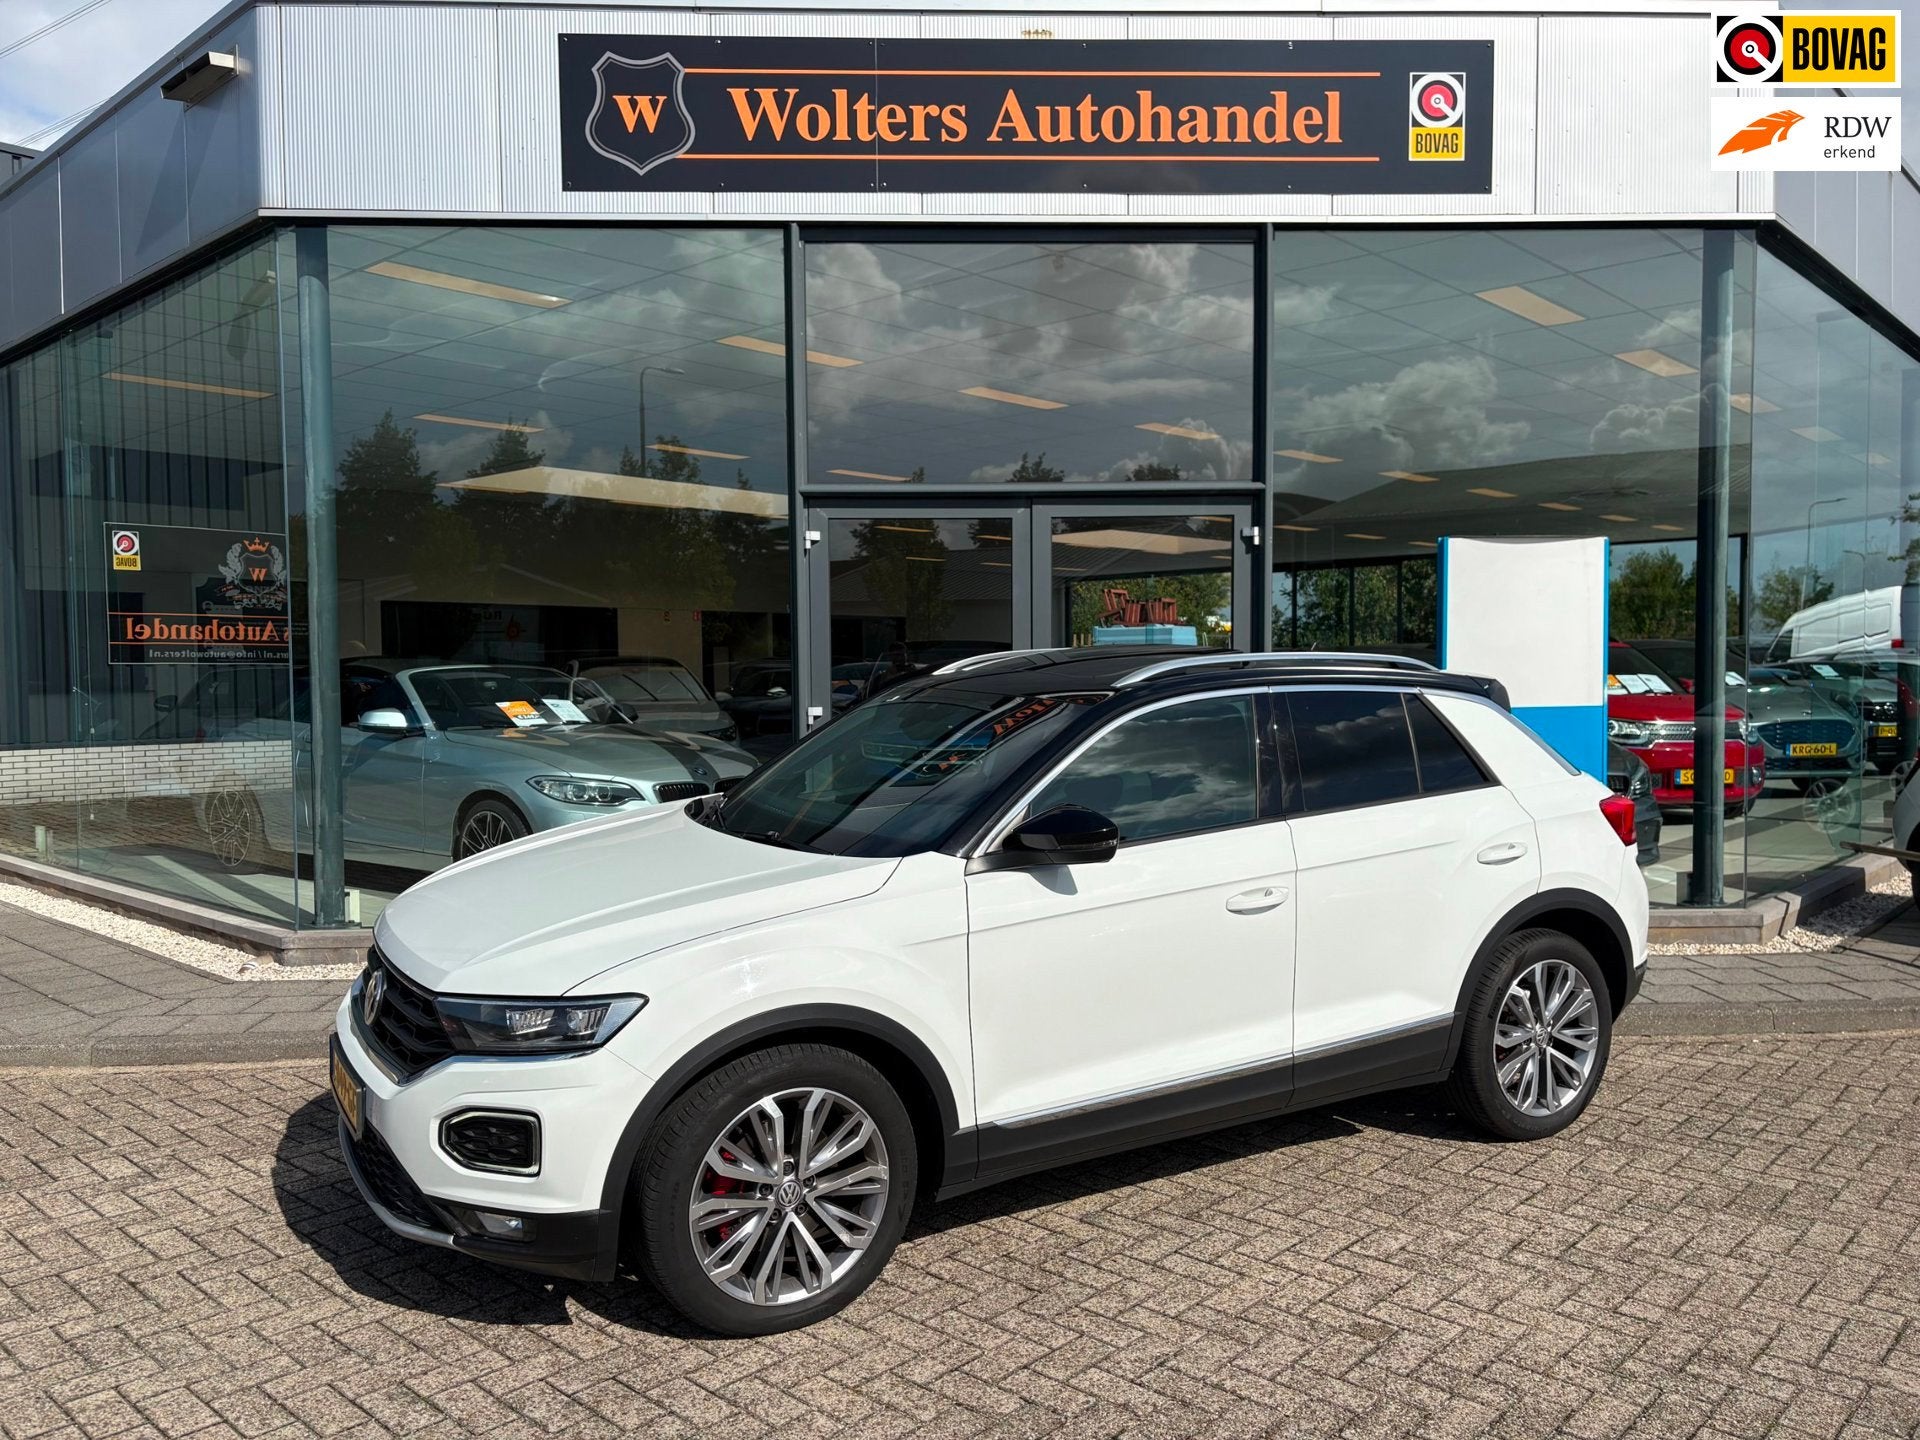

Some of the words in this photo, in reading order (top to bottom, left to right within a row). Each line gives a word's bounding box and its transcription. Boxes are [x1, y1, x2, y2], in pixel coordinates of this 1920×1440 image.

[614, 95, 666, 134] W
[727, 86, 968, 143] Wolters
[987, 89, 1343, 145] Autohandel
[1415, 133, 1459, 153] BOVAG
